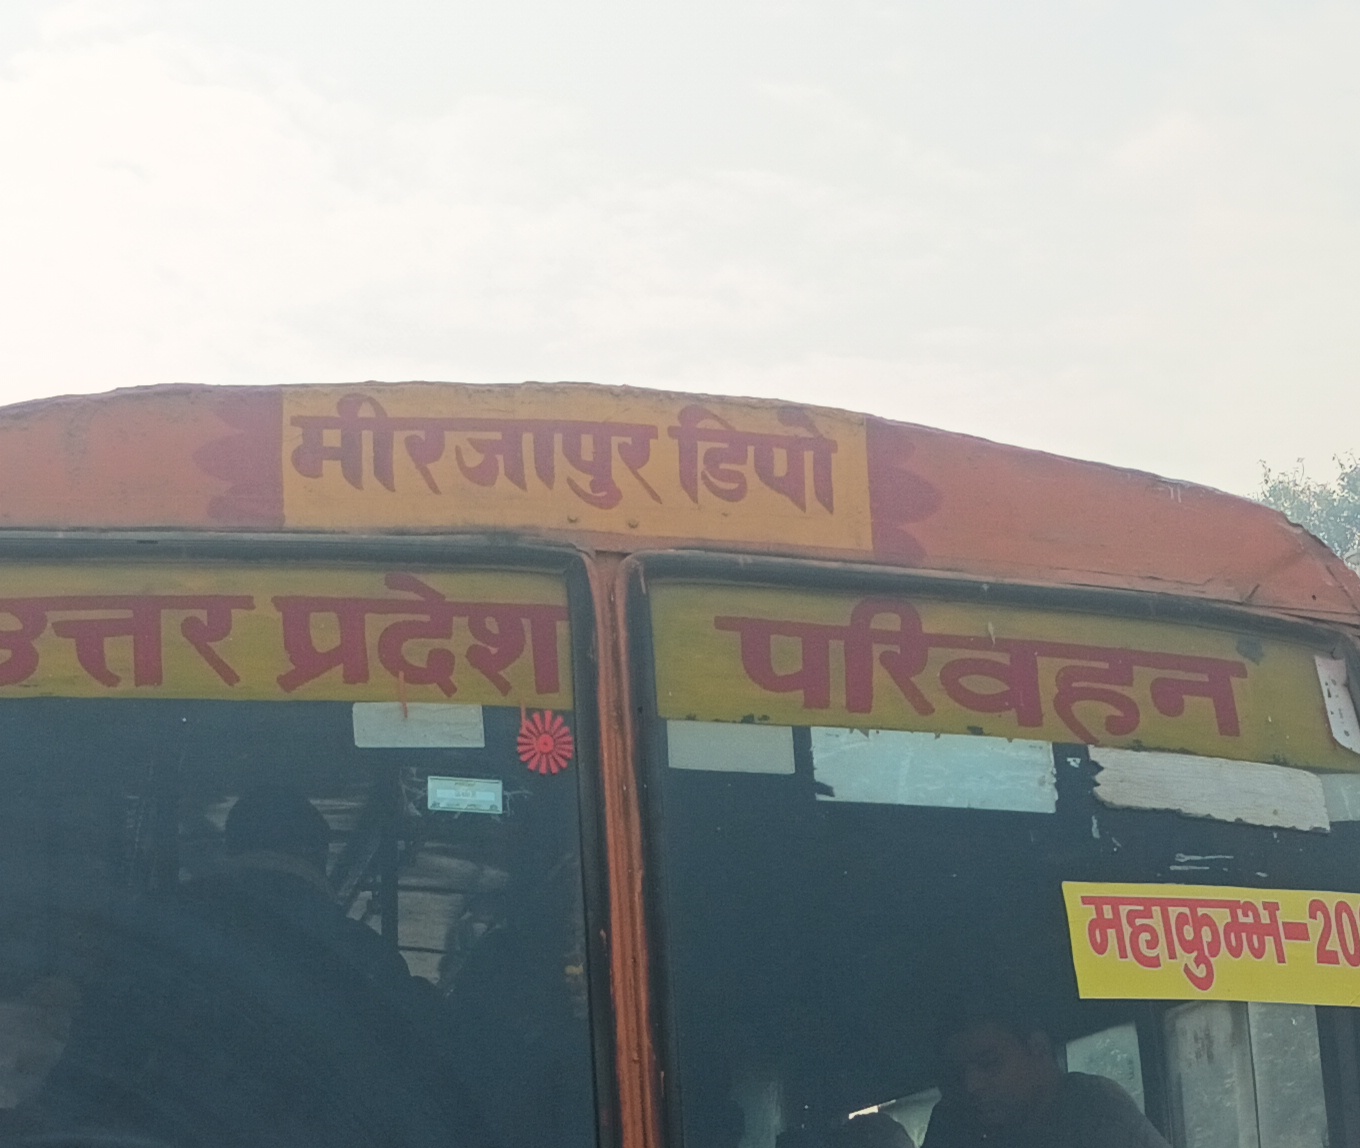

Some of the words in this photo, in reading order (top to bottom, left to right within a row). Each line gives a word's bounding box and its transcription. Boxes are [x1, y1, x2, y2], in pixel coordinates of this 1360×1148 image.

[290, 393, 663, 511] मीरजापुर
[667, 405, 838, 515] डिपो
[270, 572, 571, 697] प्रदेश
[713, 598, 1248, 745] परिवहन
